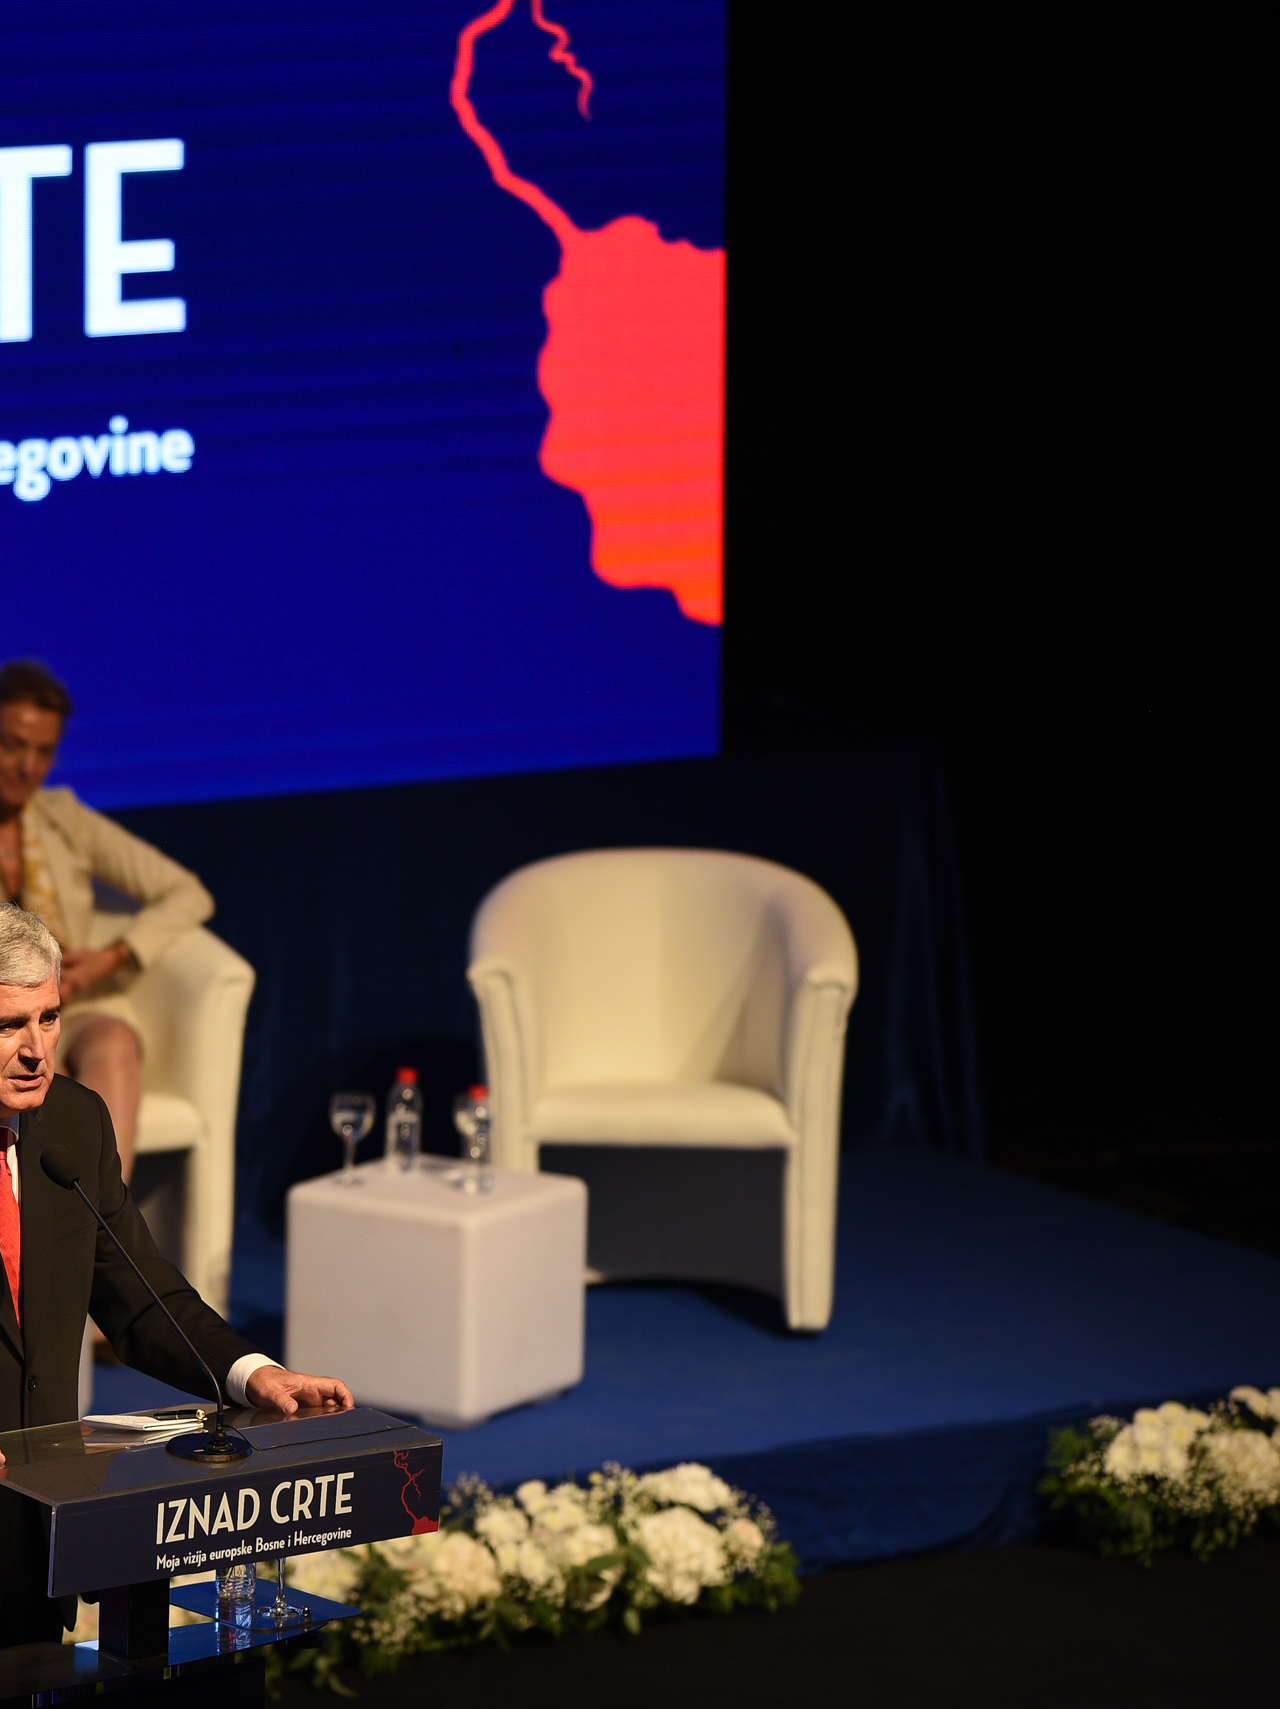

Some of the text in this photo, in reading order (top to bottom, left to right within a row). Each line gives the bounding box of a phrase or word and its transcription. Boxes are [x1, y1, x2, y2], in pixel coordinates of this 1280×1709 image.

[156, 1471, 355, 1545] IZNAD CRTE
[156, 1526, 352, 1572] Moja vizija europske Bosne i Hercegovine
